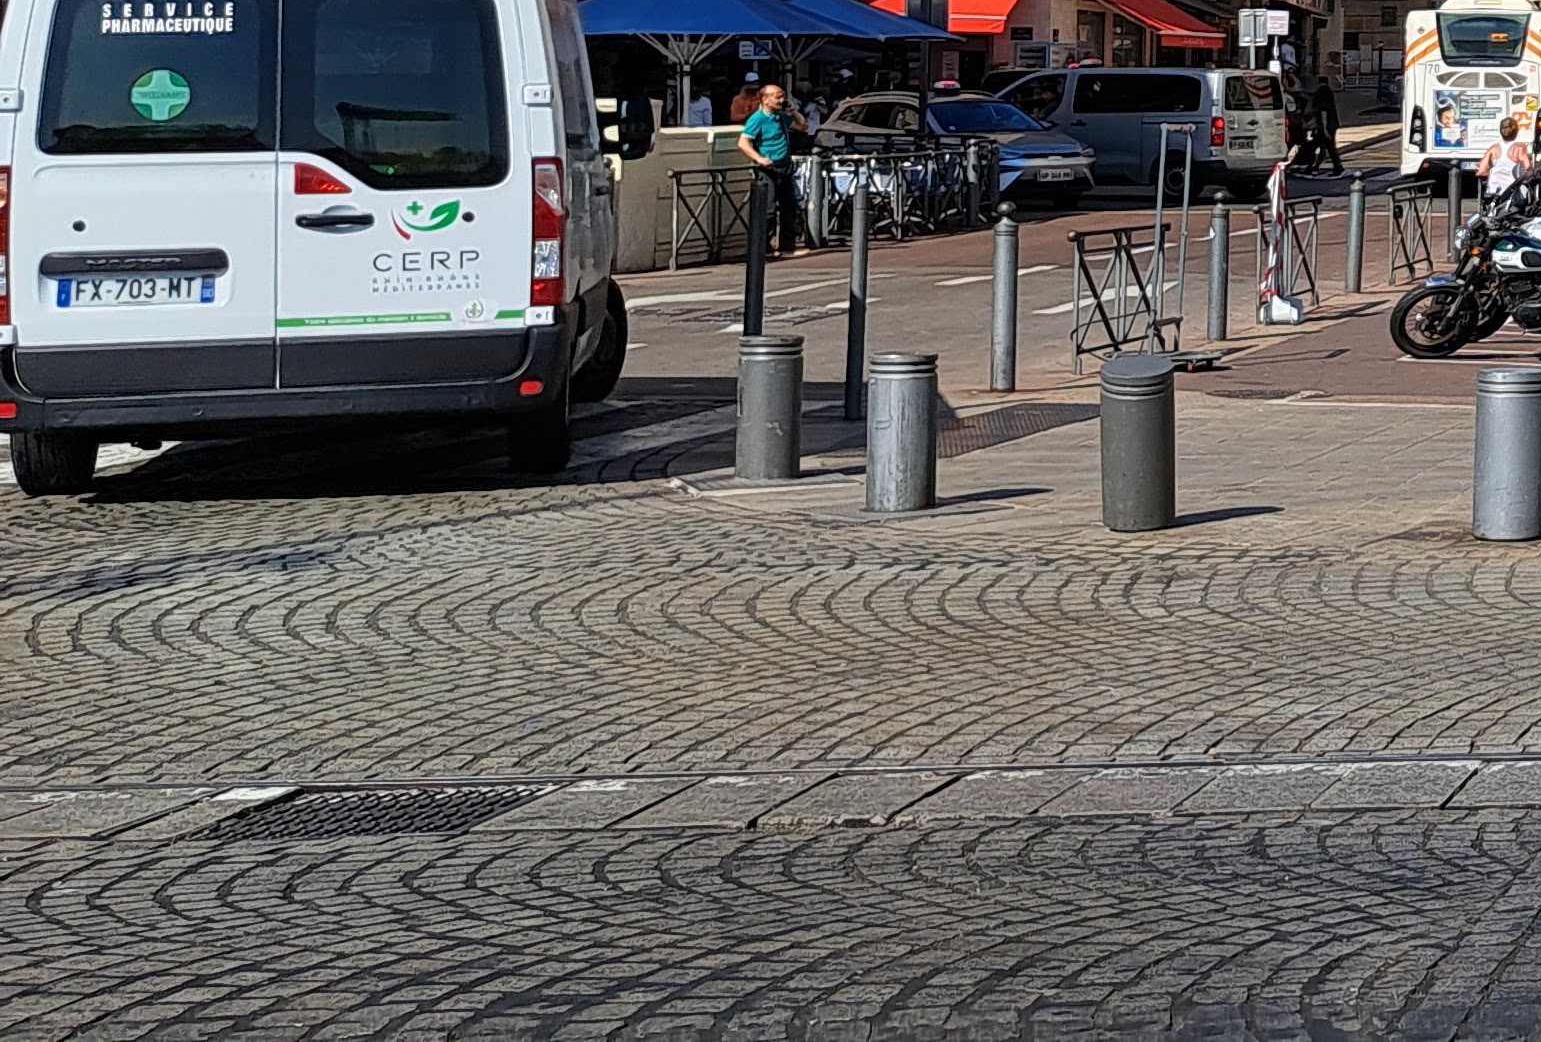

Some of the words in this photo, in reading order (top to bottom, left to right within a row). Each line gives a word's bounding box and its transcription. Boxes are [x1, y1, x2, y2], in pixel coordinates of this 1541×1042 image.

[102, 2, 234, 18] SERVICE
[102, 18, 234, 35] PHARMACEUTIQUE
[1428, 64, 1440, 74] 70
[372, 249, 481, 273] CERP
[75, 276, 197, 302] FX-703-MT
